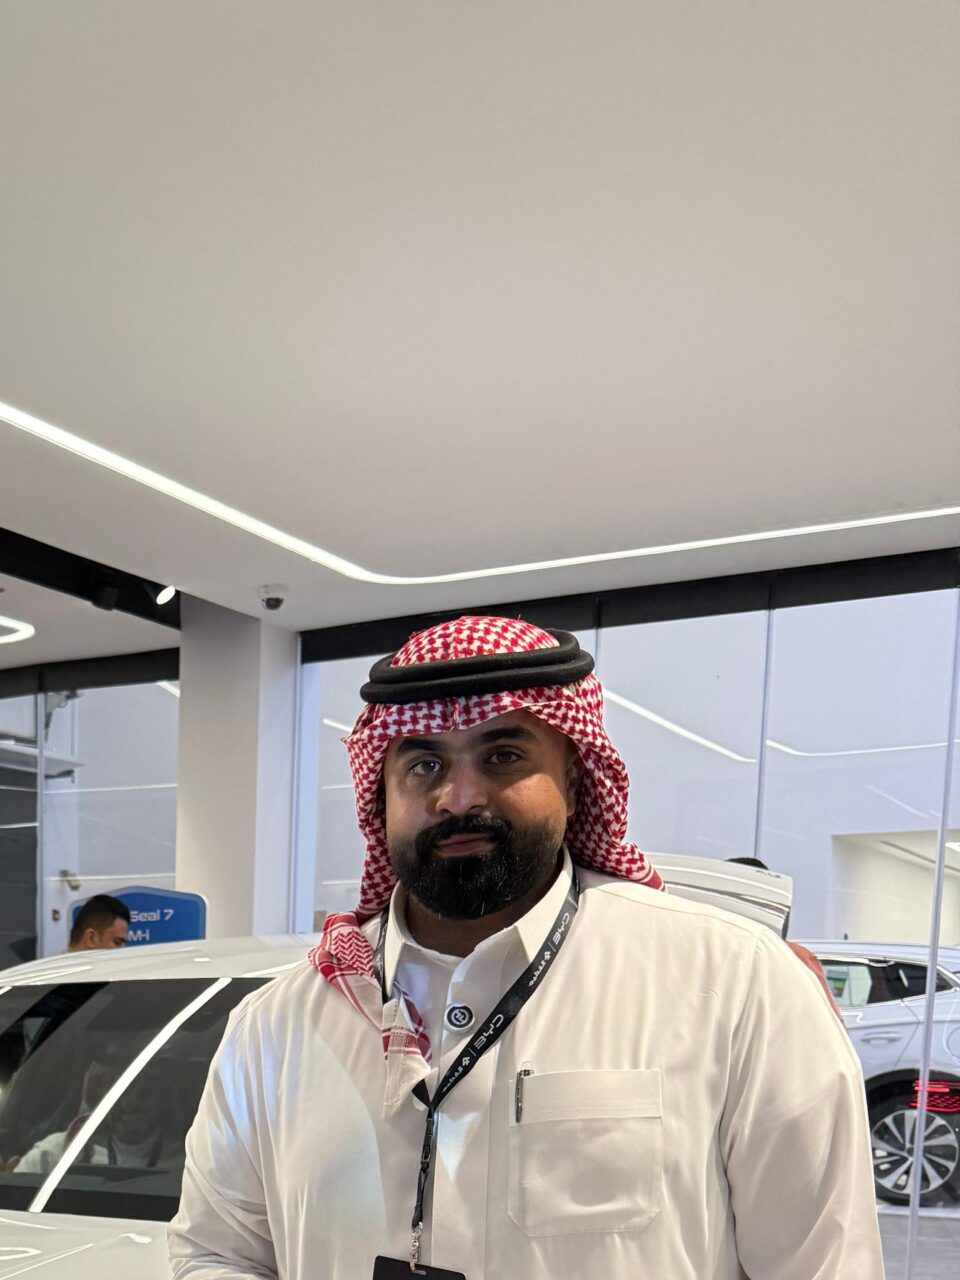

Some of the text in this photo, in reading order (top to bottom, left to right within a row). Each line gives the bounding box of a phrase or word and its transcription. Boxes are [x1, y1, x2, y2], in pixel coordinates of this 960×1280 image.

[129, 909, 175, 922] Seal 7
[127, 929, 150, 941] M-i
[552, 912, 570, 945] BYD
[473, 1013, 504, 1050] BYD
